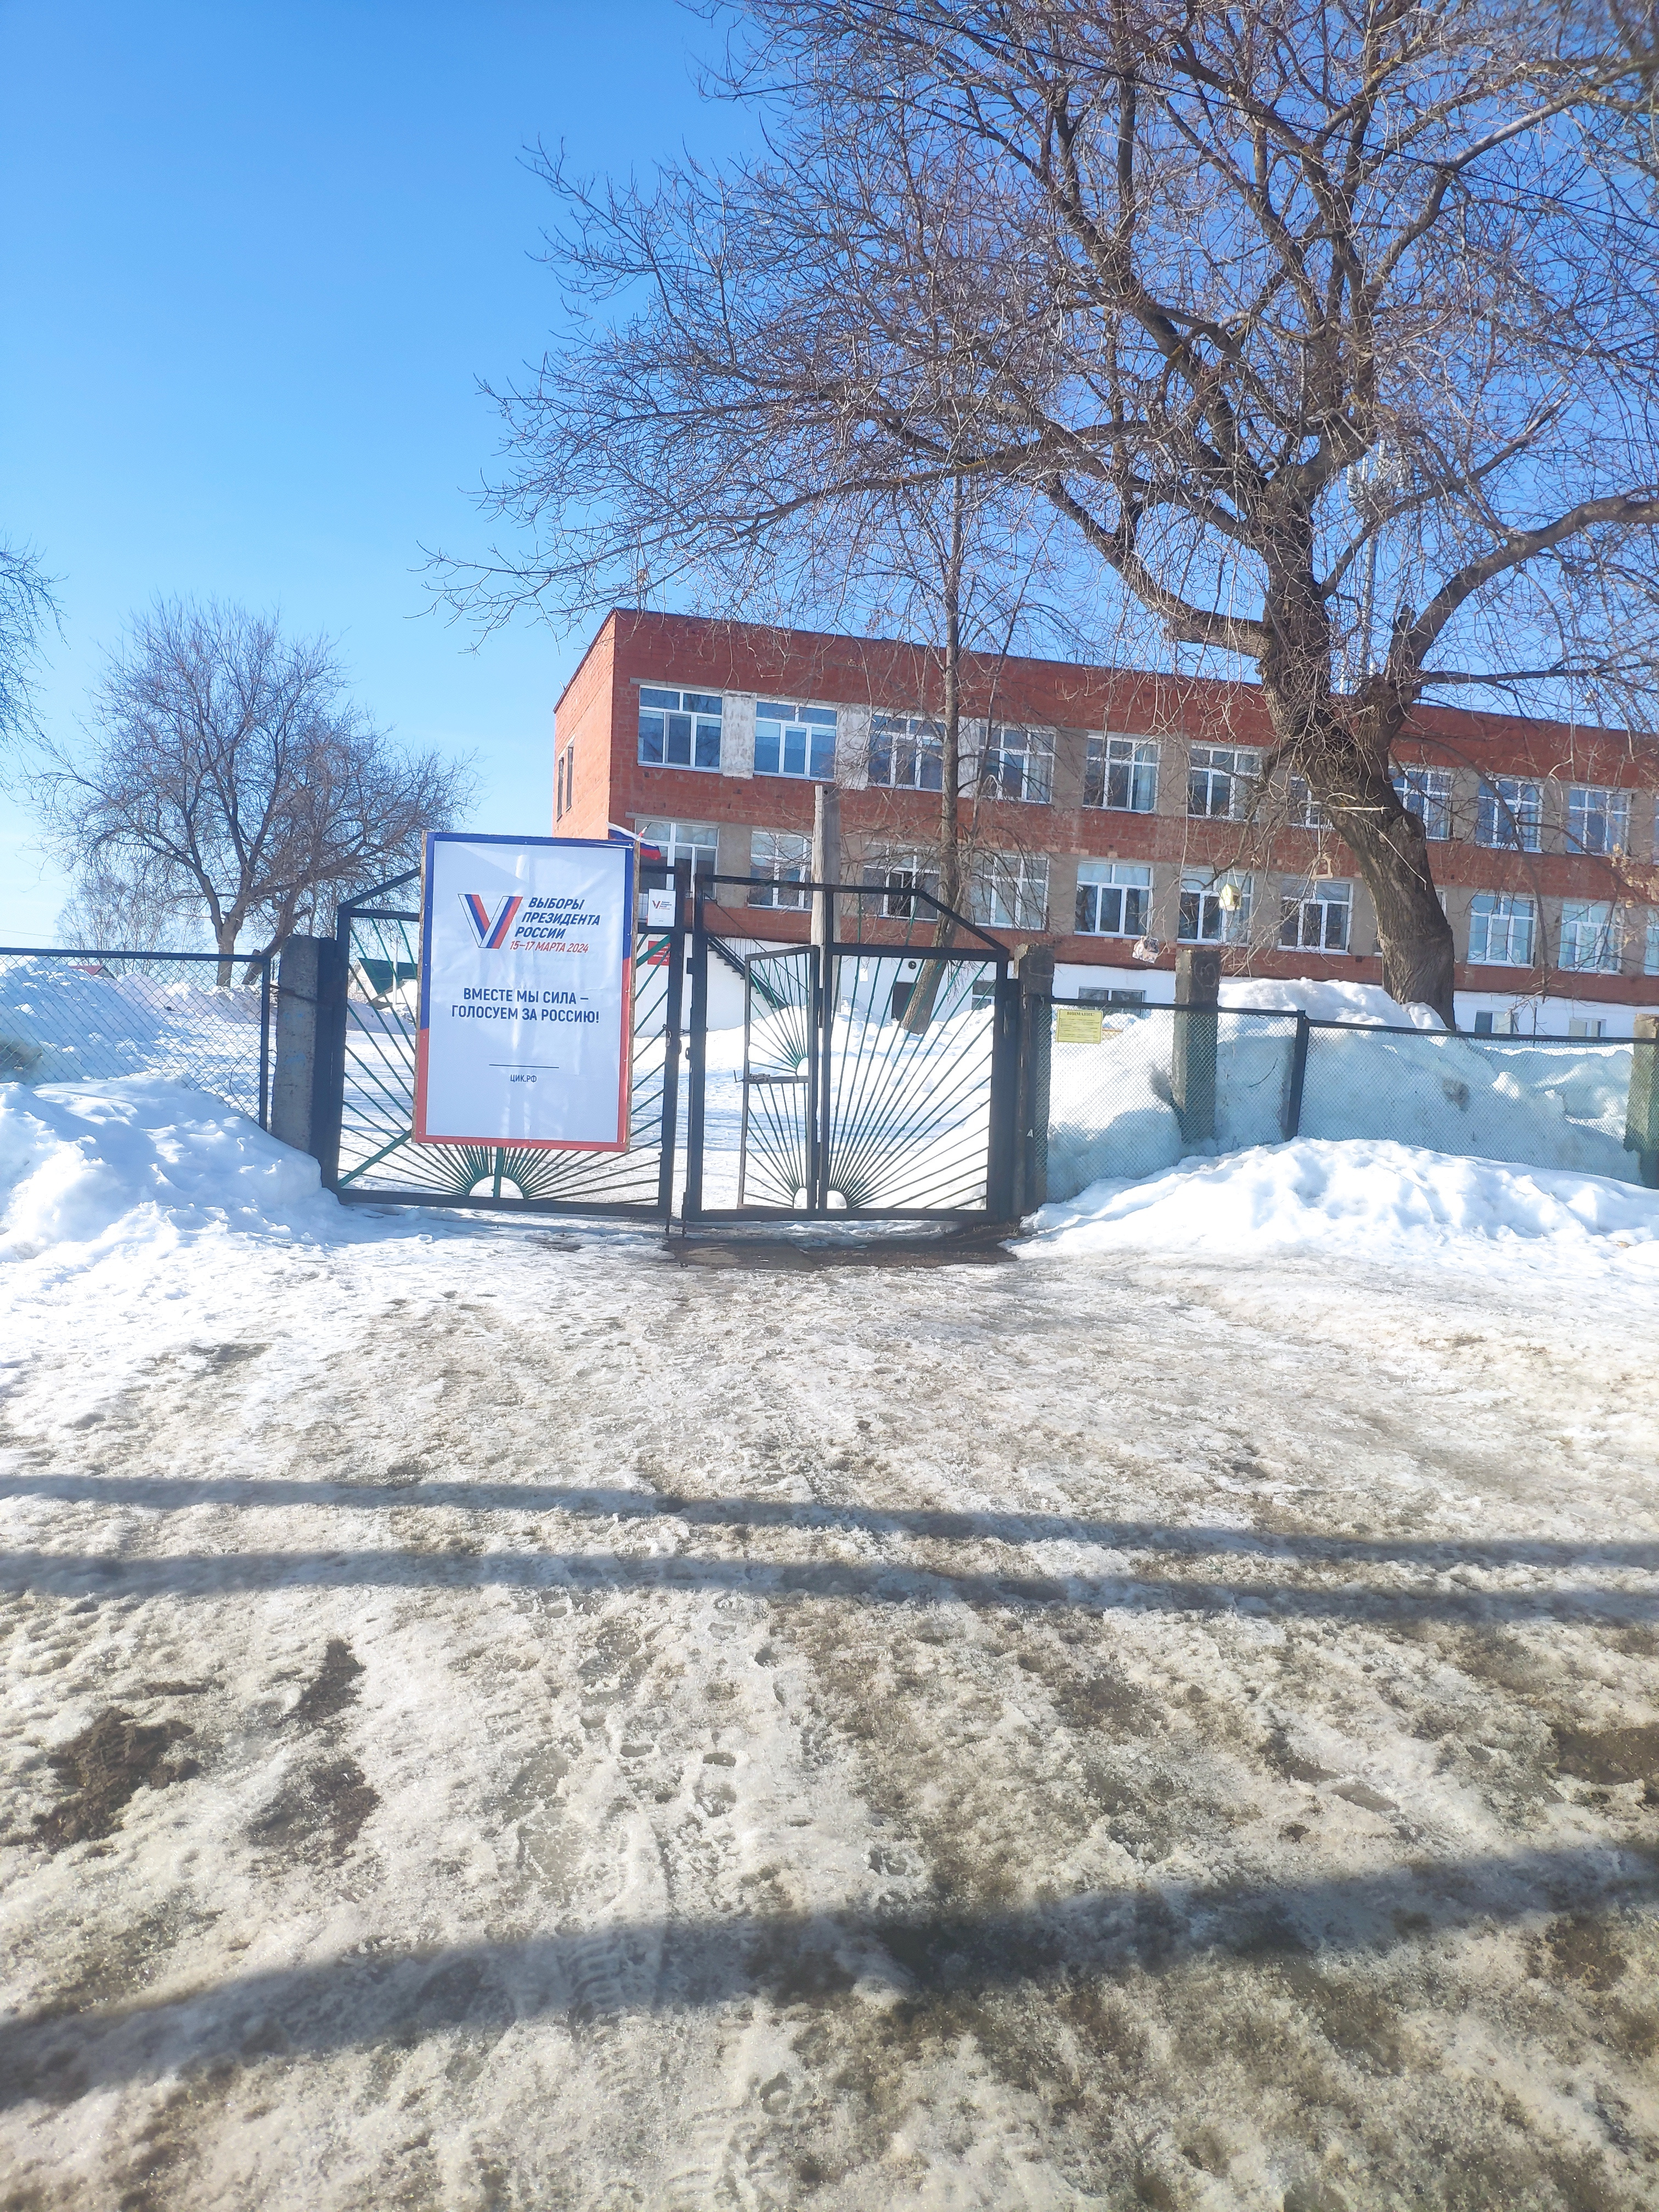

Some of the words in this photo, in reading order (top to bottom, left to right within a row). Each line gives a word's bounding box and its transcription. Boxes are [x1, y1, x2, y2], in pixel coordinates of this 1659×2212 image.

[528, 897, 585, 910] ВЫБОРЫ
[521, 912, 601, 926] ПРЕЗИДЕНТА
[515, 927, 567, 939] РОССИИ
[535, 941, 566, 952] МАРТА
[567, 943, 589, 953] 2024
[464, 988, 513, 1002] ВМЕСТЕ
[517, 990, 539, 1003] МЫ
[543, 991, 577, 1005] СИЛА
[452, 1005, 518, 1020] ГОЛОСУЕМ
[522, 1008, 537, 1020] ЗА
[541, 1009, 599, 1023] РОССИЮ!
[510, 1074, 537, 1083] ЦИК.РФ
